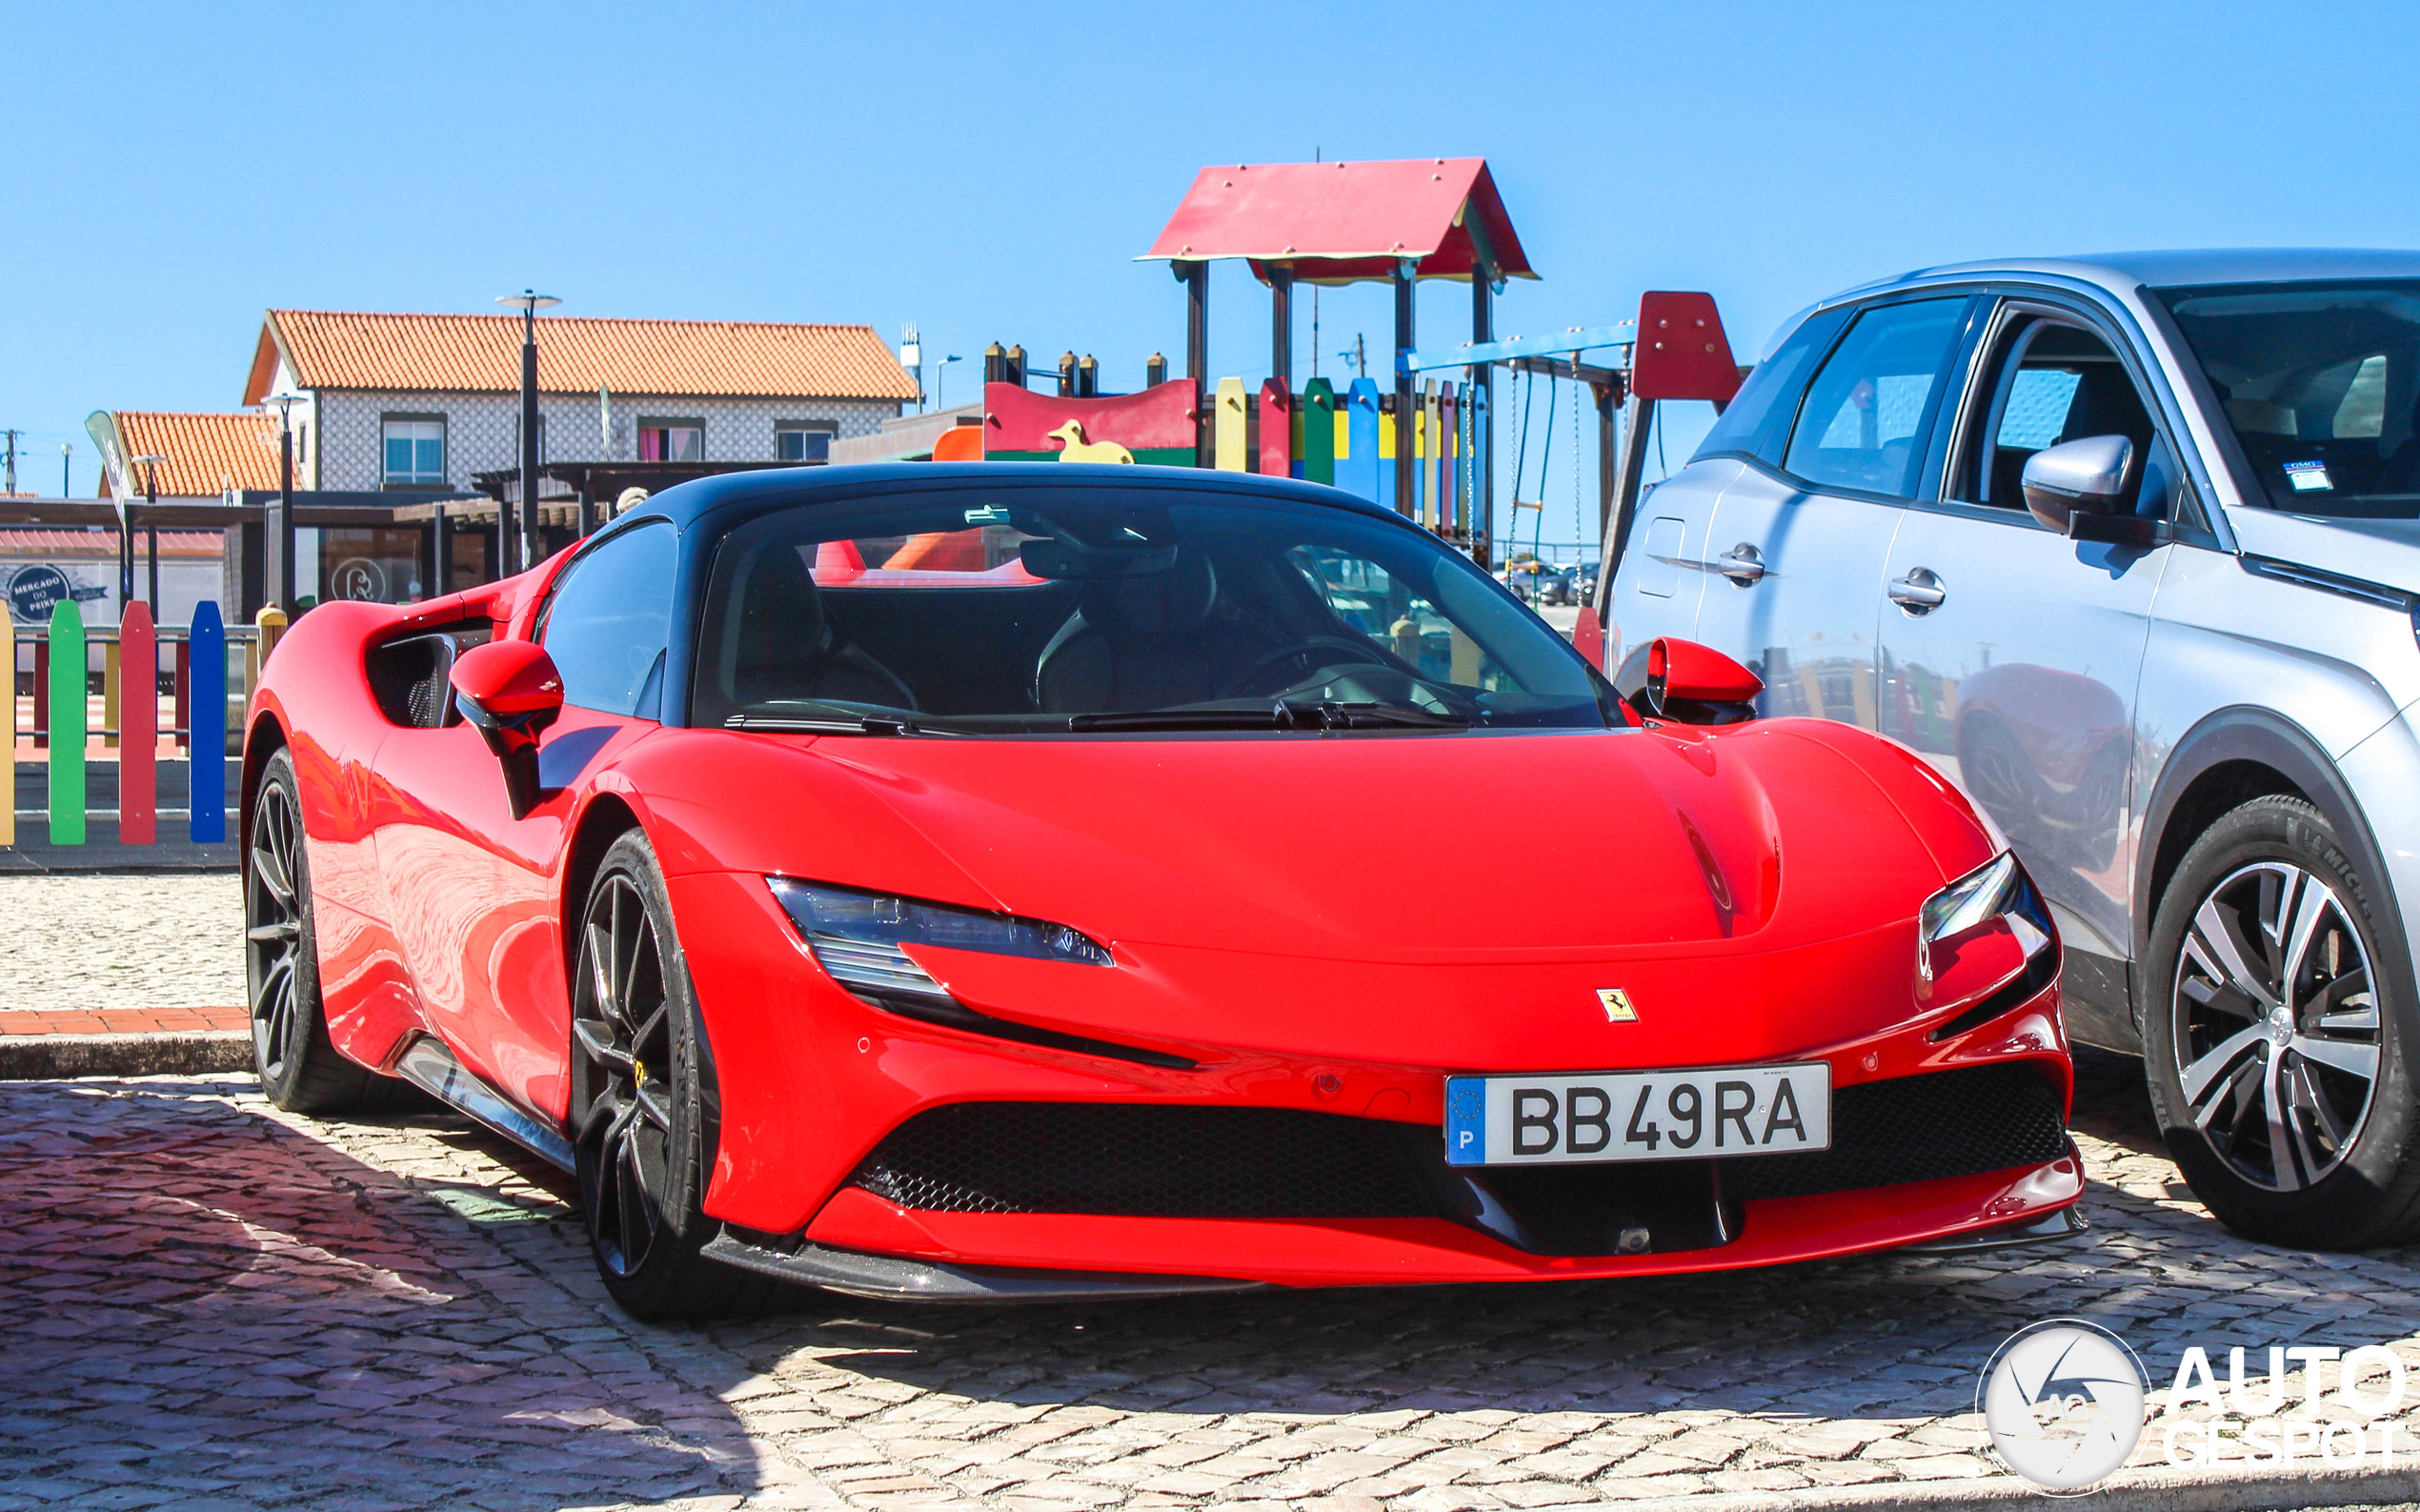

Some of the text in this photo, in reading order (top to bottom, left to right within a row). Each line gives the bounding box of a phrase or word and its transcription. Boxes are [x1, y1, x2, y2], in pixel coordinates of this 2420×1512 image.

[14, 576, 60, 595] MERCADO
[32, 590, 48, 600] DO
[30, 597, 55, 612] PEIXE
[1460, 1130, 1475, 1150] P
